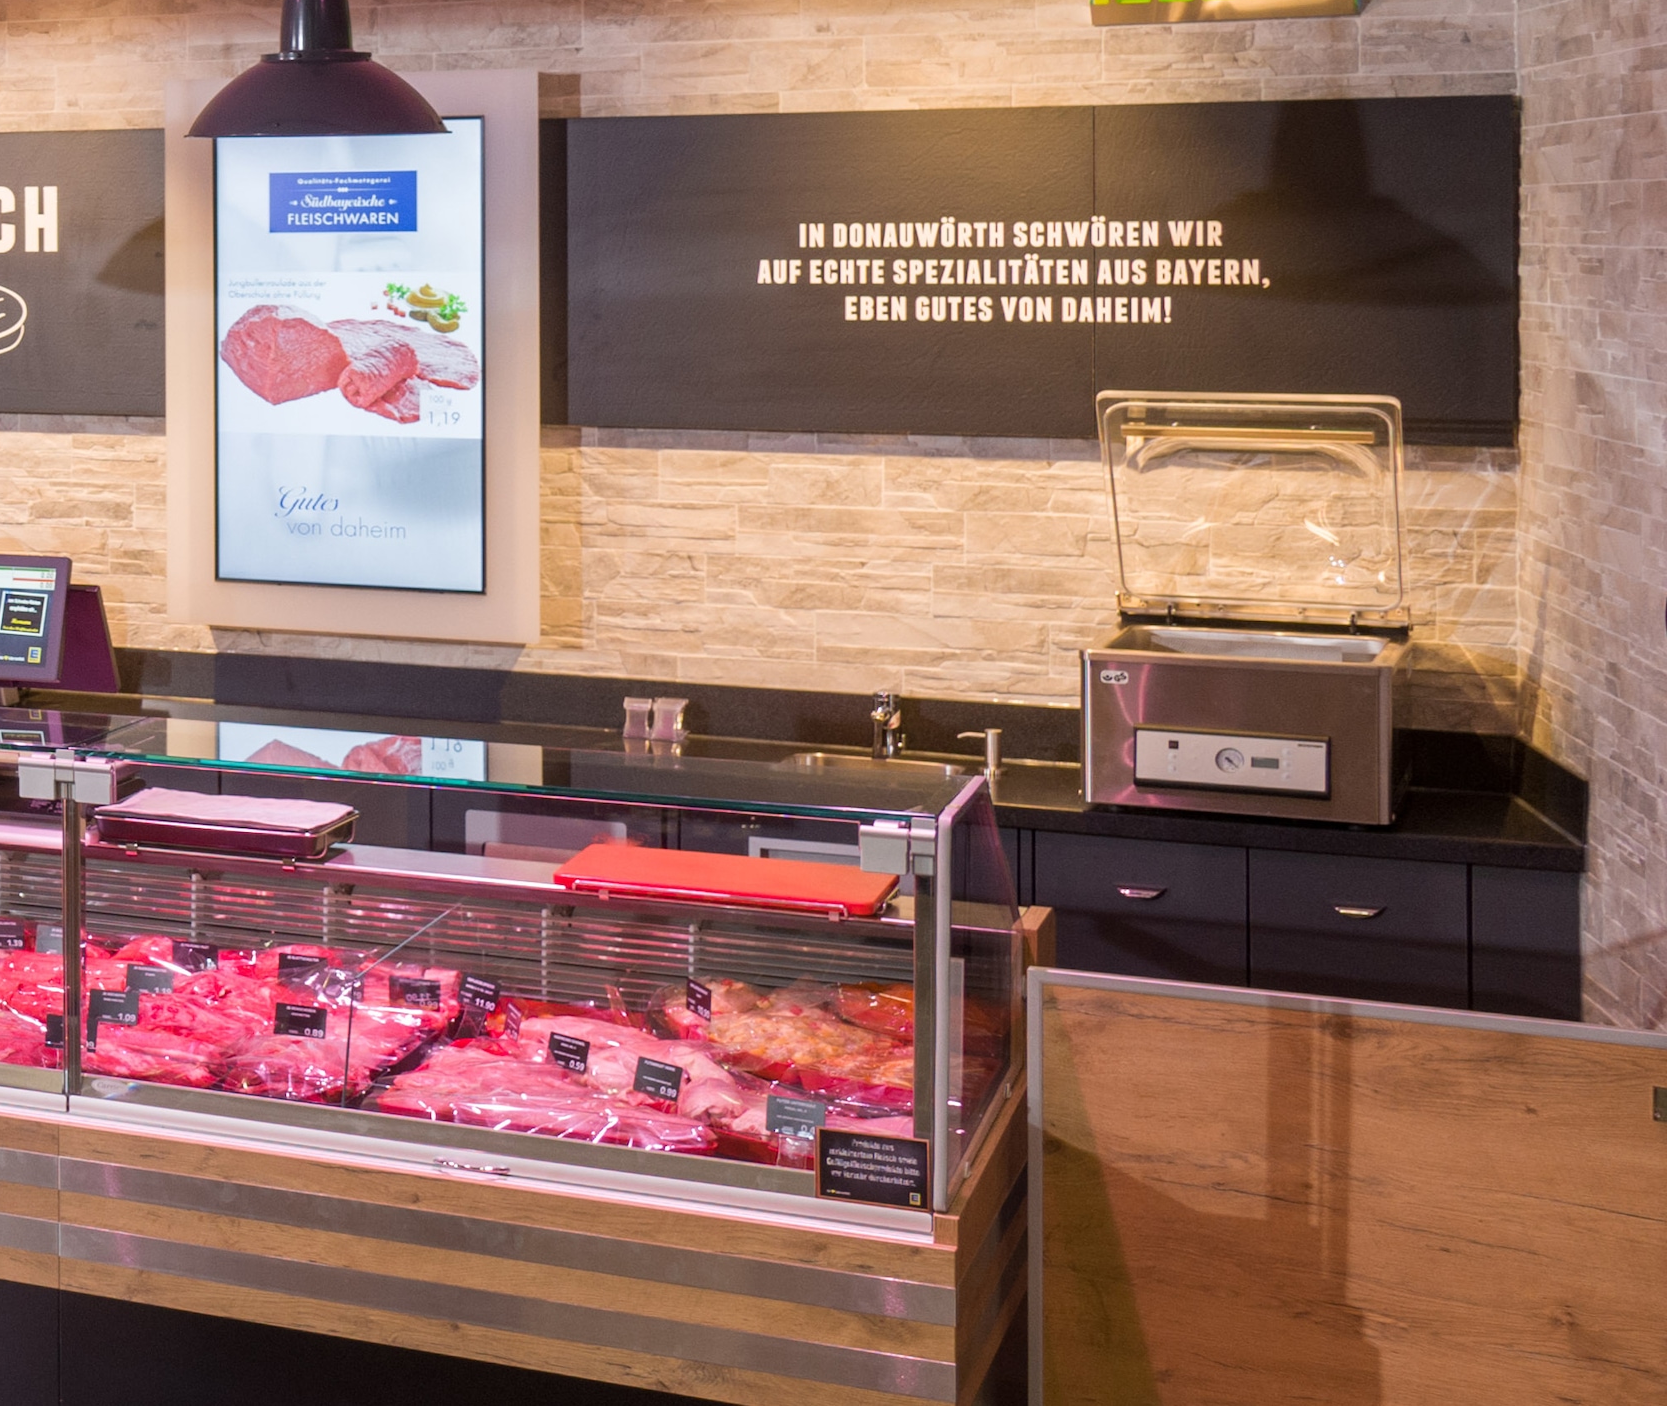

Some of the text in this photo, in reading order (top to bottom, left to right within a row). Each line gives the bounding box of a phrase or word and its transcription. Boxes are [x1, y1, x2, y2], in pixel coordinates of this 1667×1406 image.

[300, 194, 385, 211] Südbayerische
[287, 212, 399, 225] FLEISCHWAREN
[799, 216, 1223, 248] IN DONAUWÖRTH SCHWÖREN WIR
[757, 254, 1270, 289] AUF ECHTE SPEZIALITÄTEN AUS BAYERN,
[845, 296, 1172, 323] EBEN GUTES VON DAHEIM!
[429, 411, 461, 426] 1,19
[274, 486, 339, 517] Gutes
[287, 516, 406, 539] von daheim
[474, 998, 495, 1011] 11.90
[117, 1012, 136, 1023] 1.09
[569, 1058, 585, 1072] 0.59
[659, 1085, 677, 1098] 0.99
